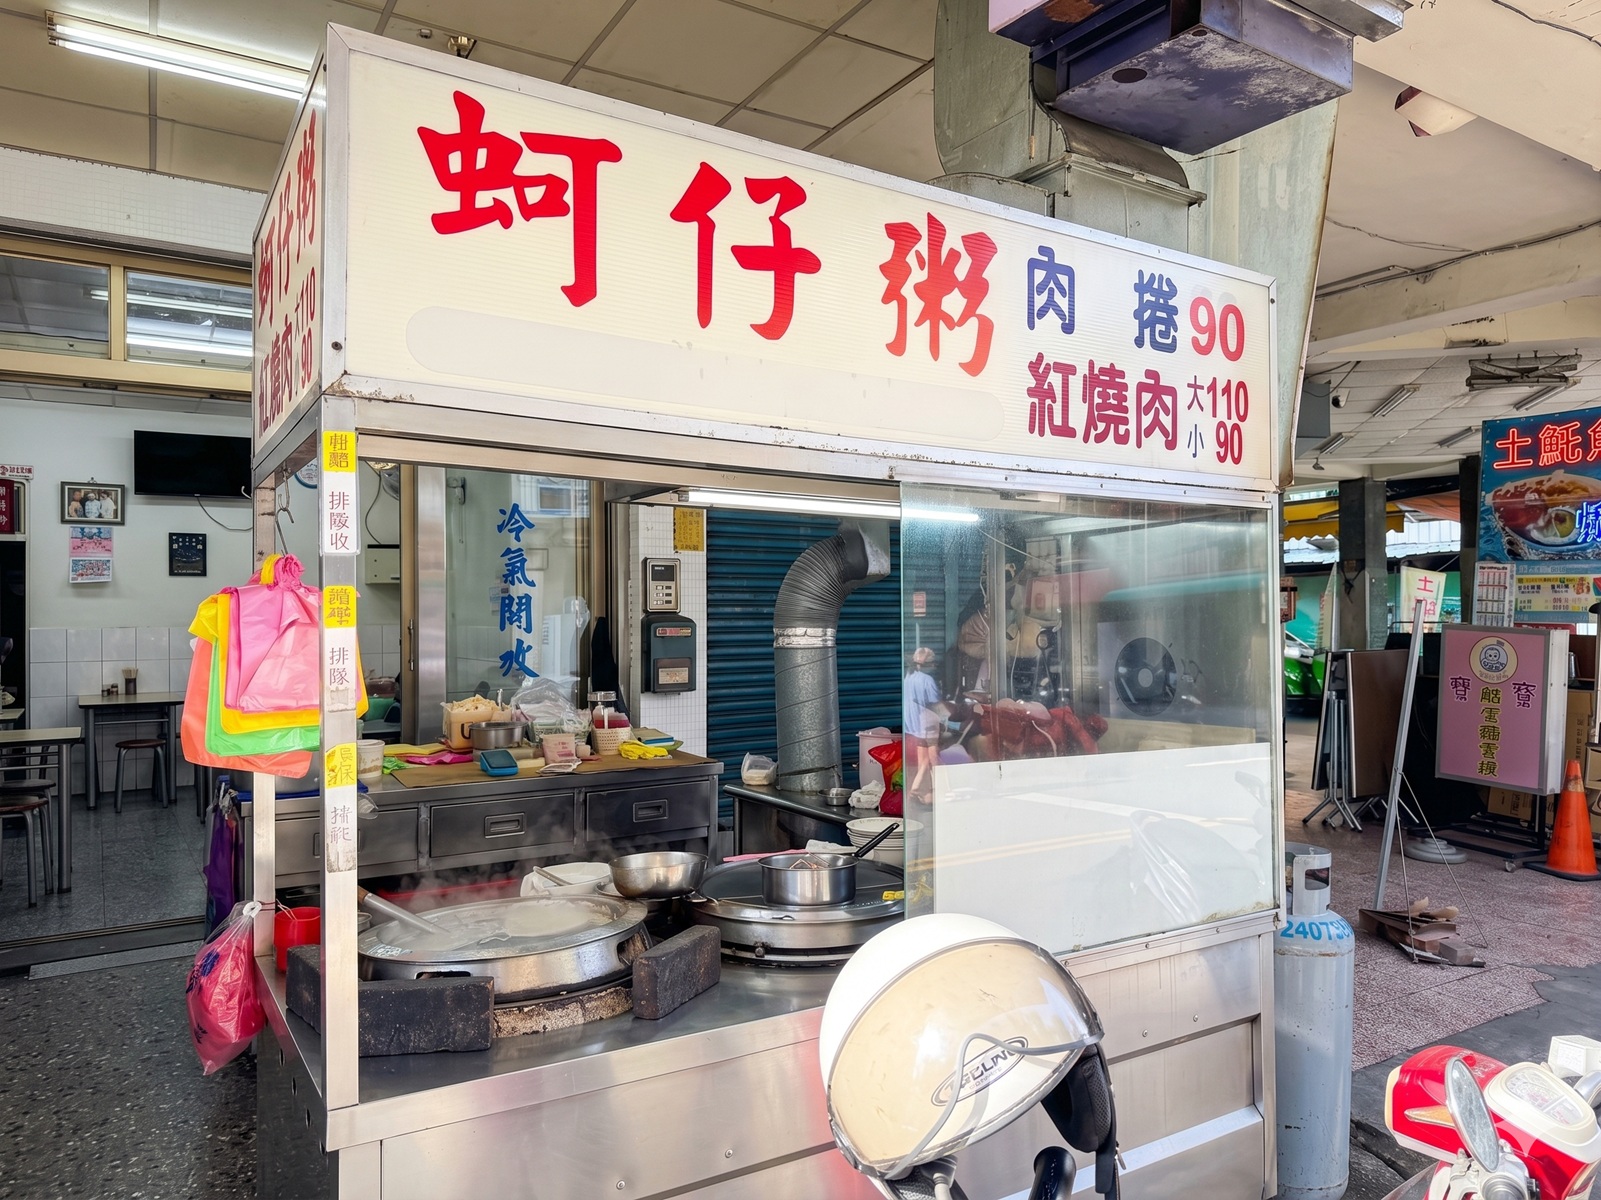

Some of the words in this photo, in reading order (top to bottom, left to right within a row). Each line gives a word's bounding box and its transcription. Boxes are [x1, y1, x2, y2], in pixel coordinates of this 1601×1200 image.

[417, 91, 998, 377] 蚵仔粥
[1189, 296, 1245, 362] 90
[1026, 352, 1179, 451] 紅燒肉
[1186, 374, 1205, 412] 大
[1206, 376, 1249, 423] 110
[1187, 423, 1205, 458] 小
[1215, 421, 1243, 465] 90
